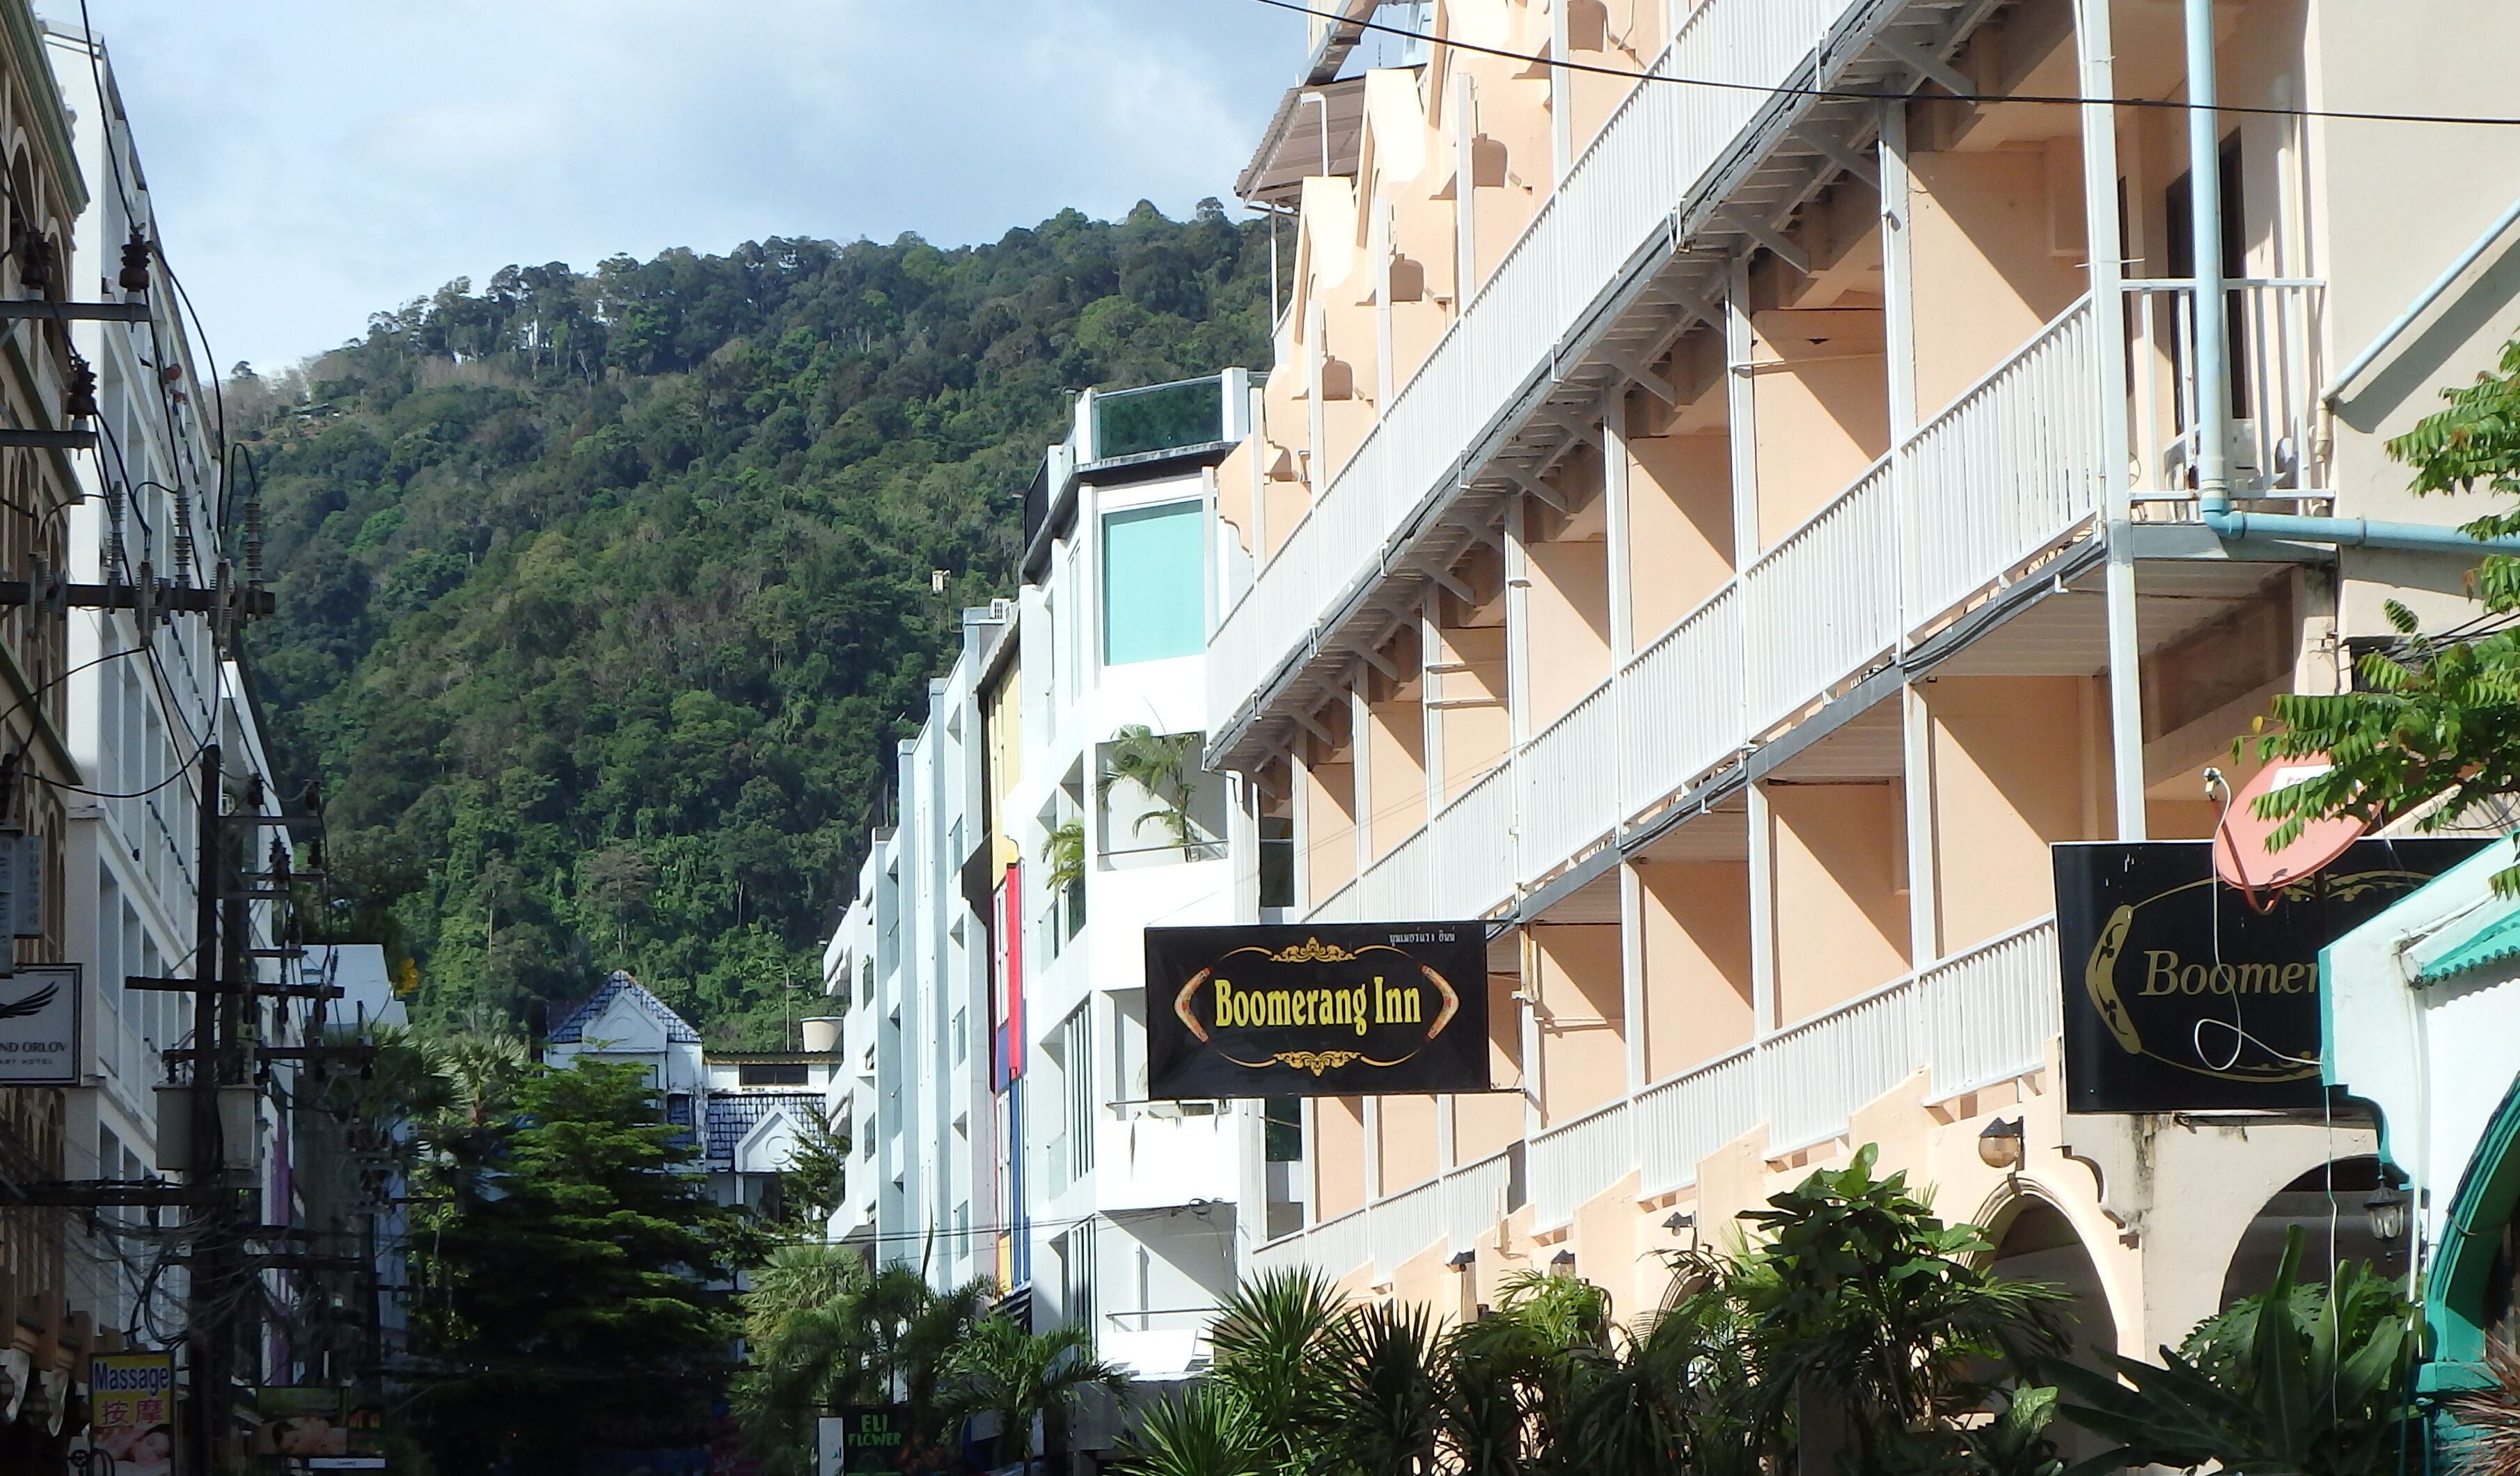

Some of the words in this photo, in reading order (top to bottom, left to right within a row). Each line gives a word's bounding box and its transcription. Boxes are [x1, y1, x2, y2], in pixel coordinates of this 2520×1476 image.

[1214, 979, 1367, 1037] Boomerang
[1373, 976, 1422, 1023] Inn
[22, 1042, 67, 1053] ORLOV
[95, 1362, 169, 1397] Massage
[100, 1399, 164, 1425] 按摩
[861, 1414, 888, 1433] ELI
[848, 1432, 902, 1447] FLOWER
